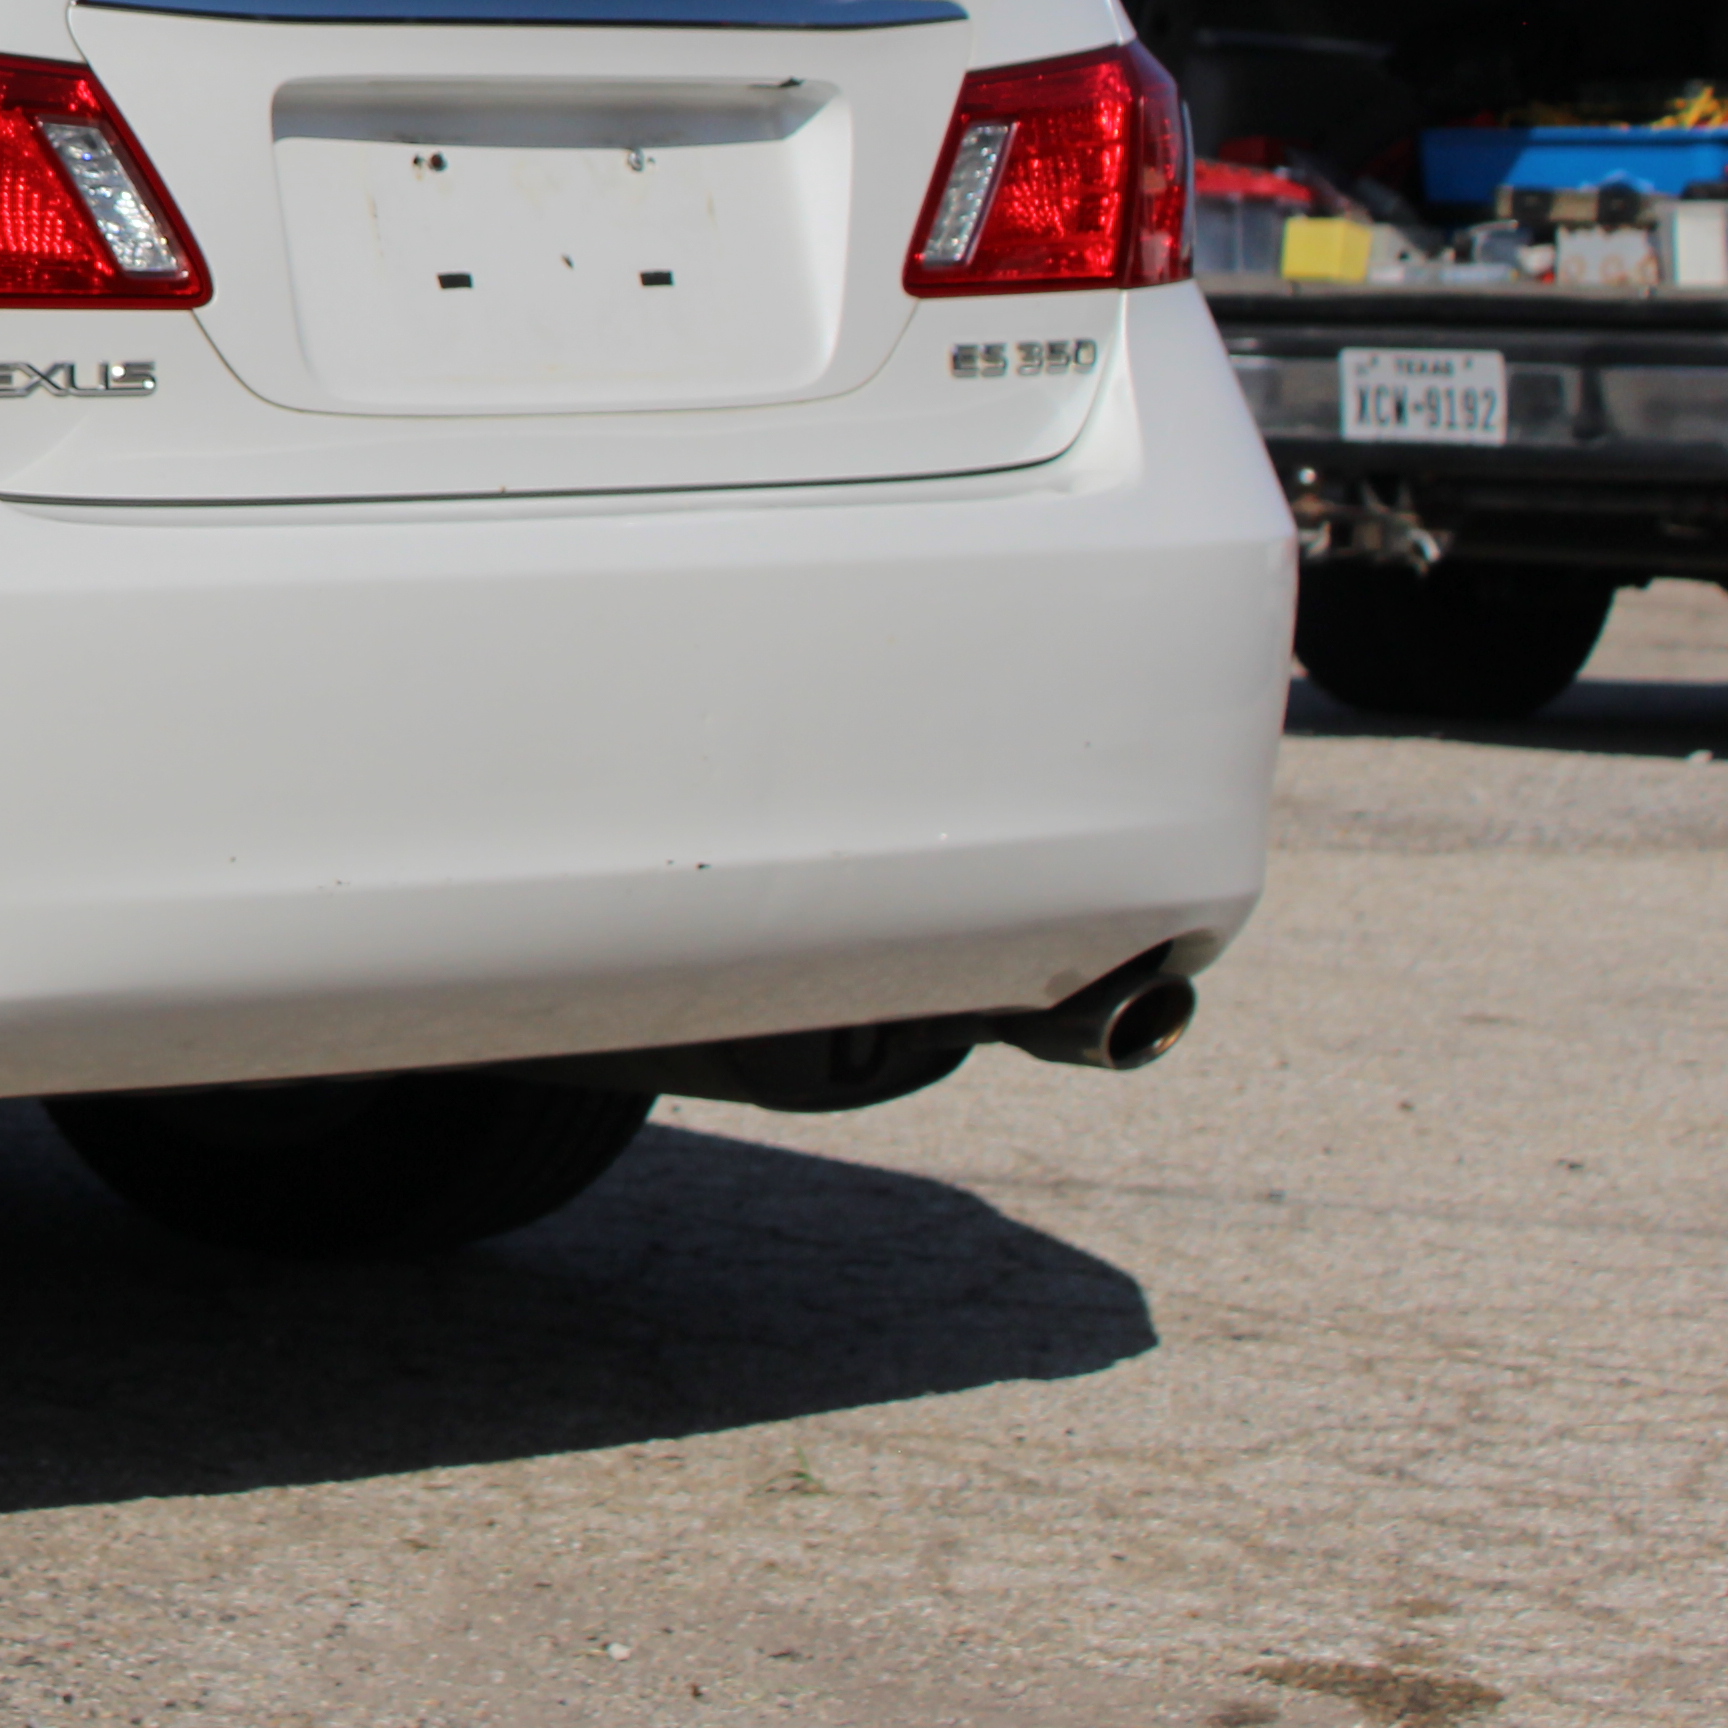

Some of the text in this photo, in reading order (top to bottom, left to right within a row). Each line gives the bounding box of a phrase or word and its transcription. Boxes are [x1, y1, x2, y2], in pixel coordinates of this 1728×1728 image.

[951, 338, 1098, 378] ES 350
[1396, 357, 1455, 376] TEXAS
